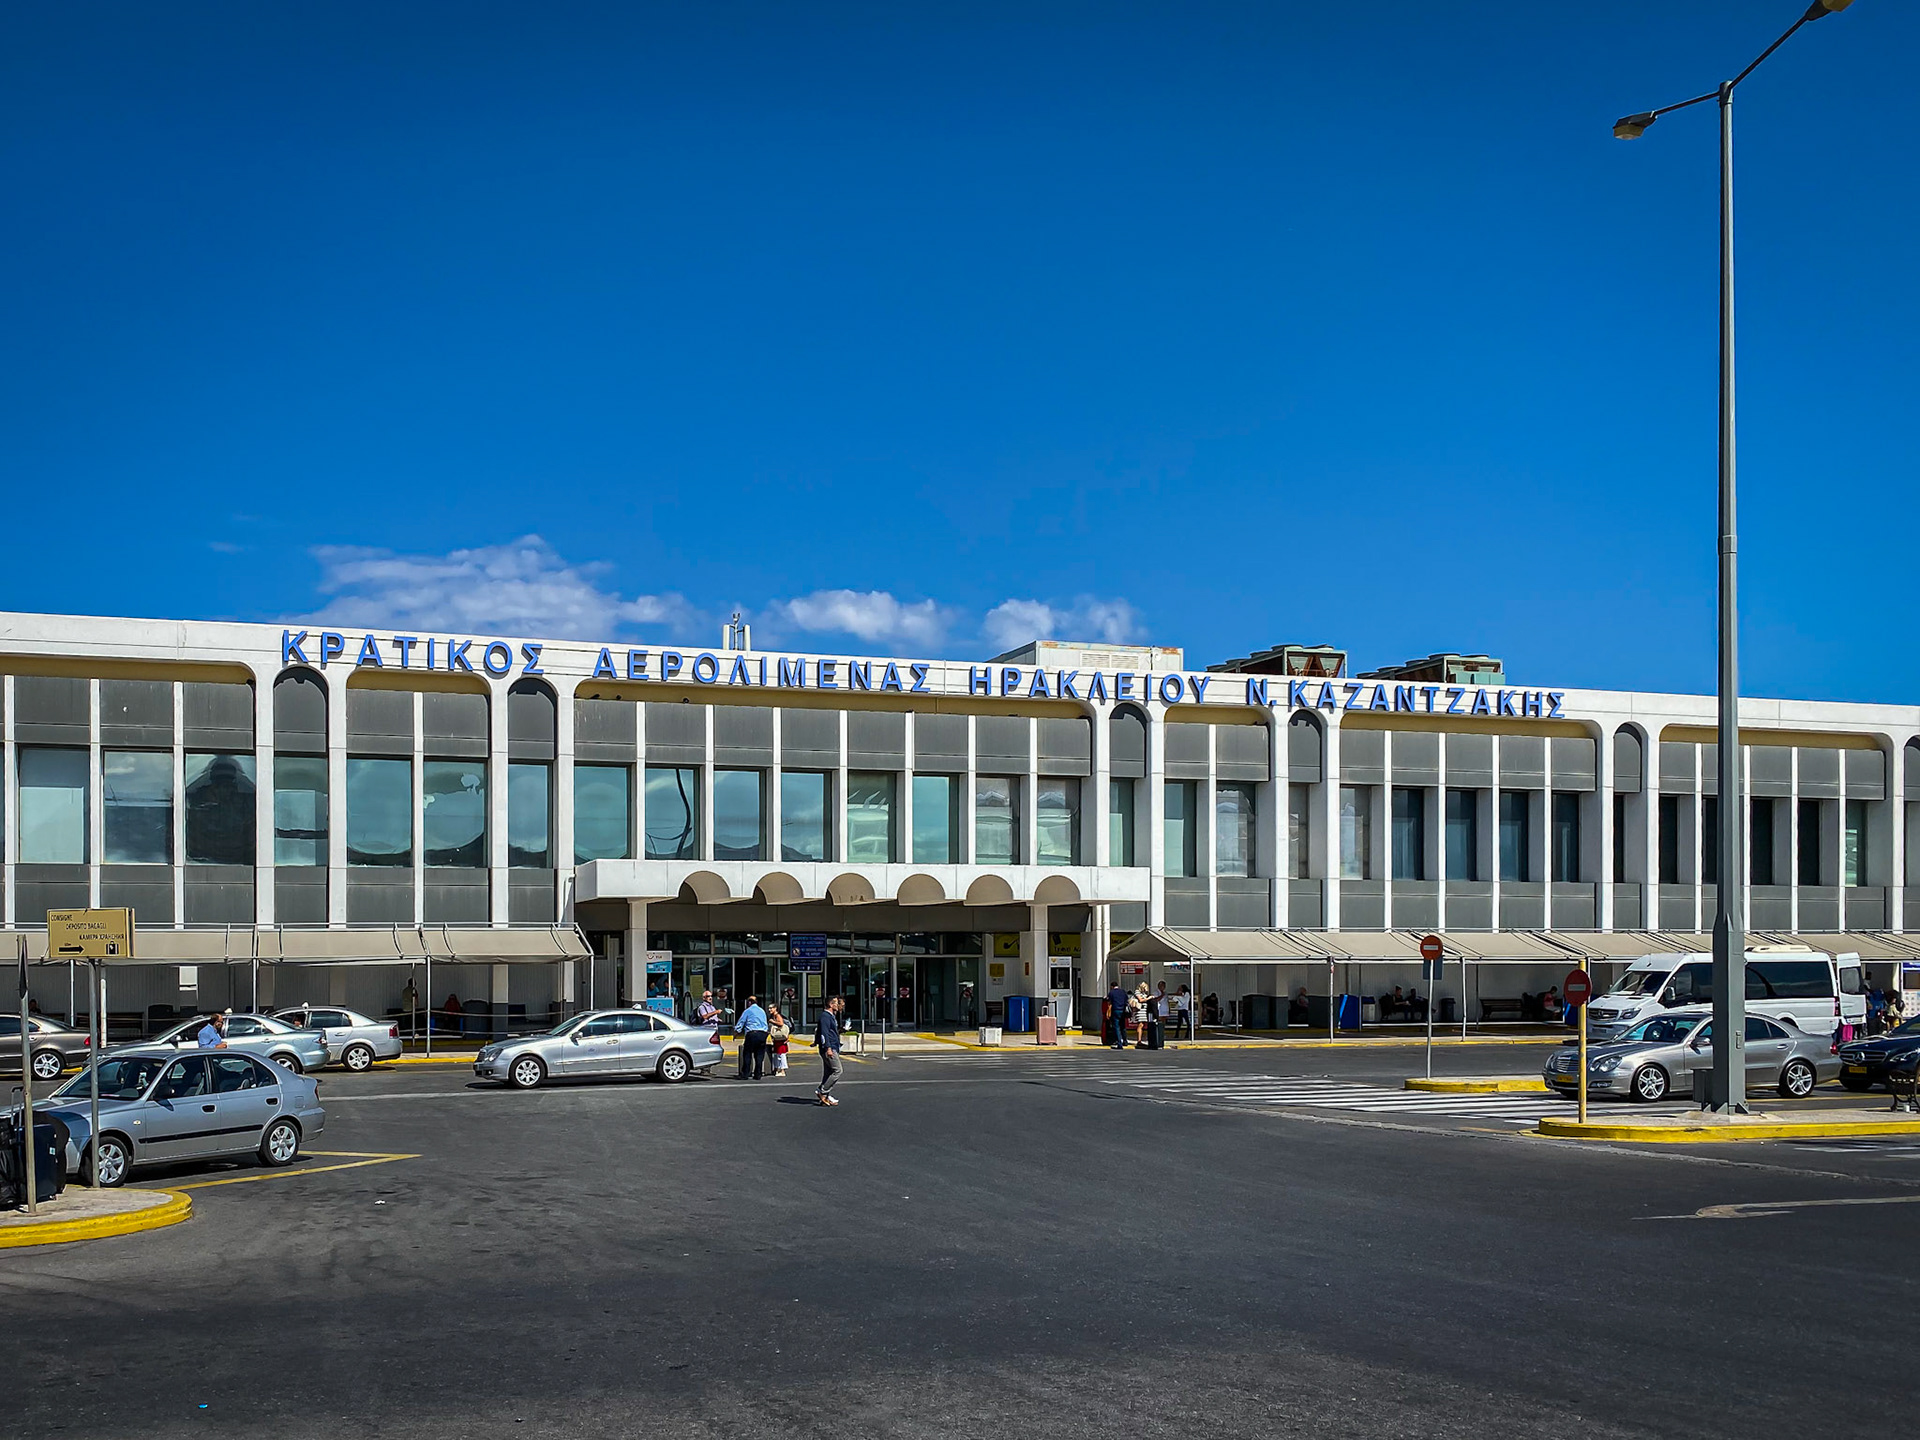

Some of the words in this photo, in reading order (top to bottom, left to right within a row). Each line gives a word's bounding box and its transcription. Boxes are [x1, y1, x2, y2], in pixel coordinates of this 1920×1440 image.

[282, 629, 545, 675] ΚΡΑΤΙΚΟΣ
[592, 647, 931, 693] ΑΕΡΟΛΙΜΕΝΑΣ
[969, 665, 1212, 705] ΗΡΑΚΛΕΙΟΥ
